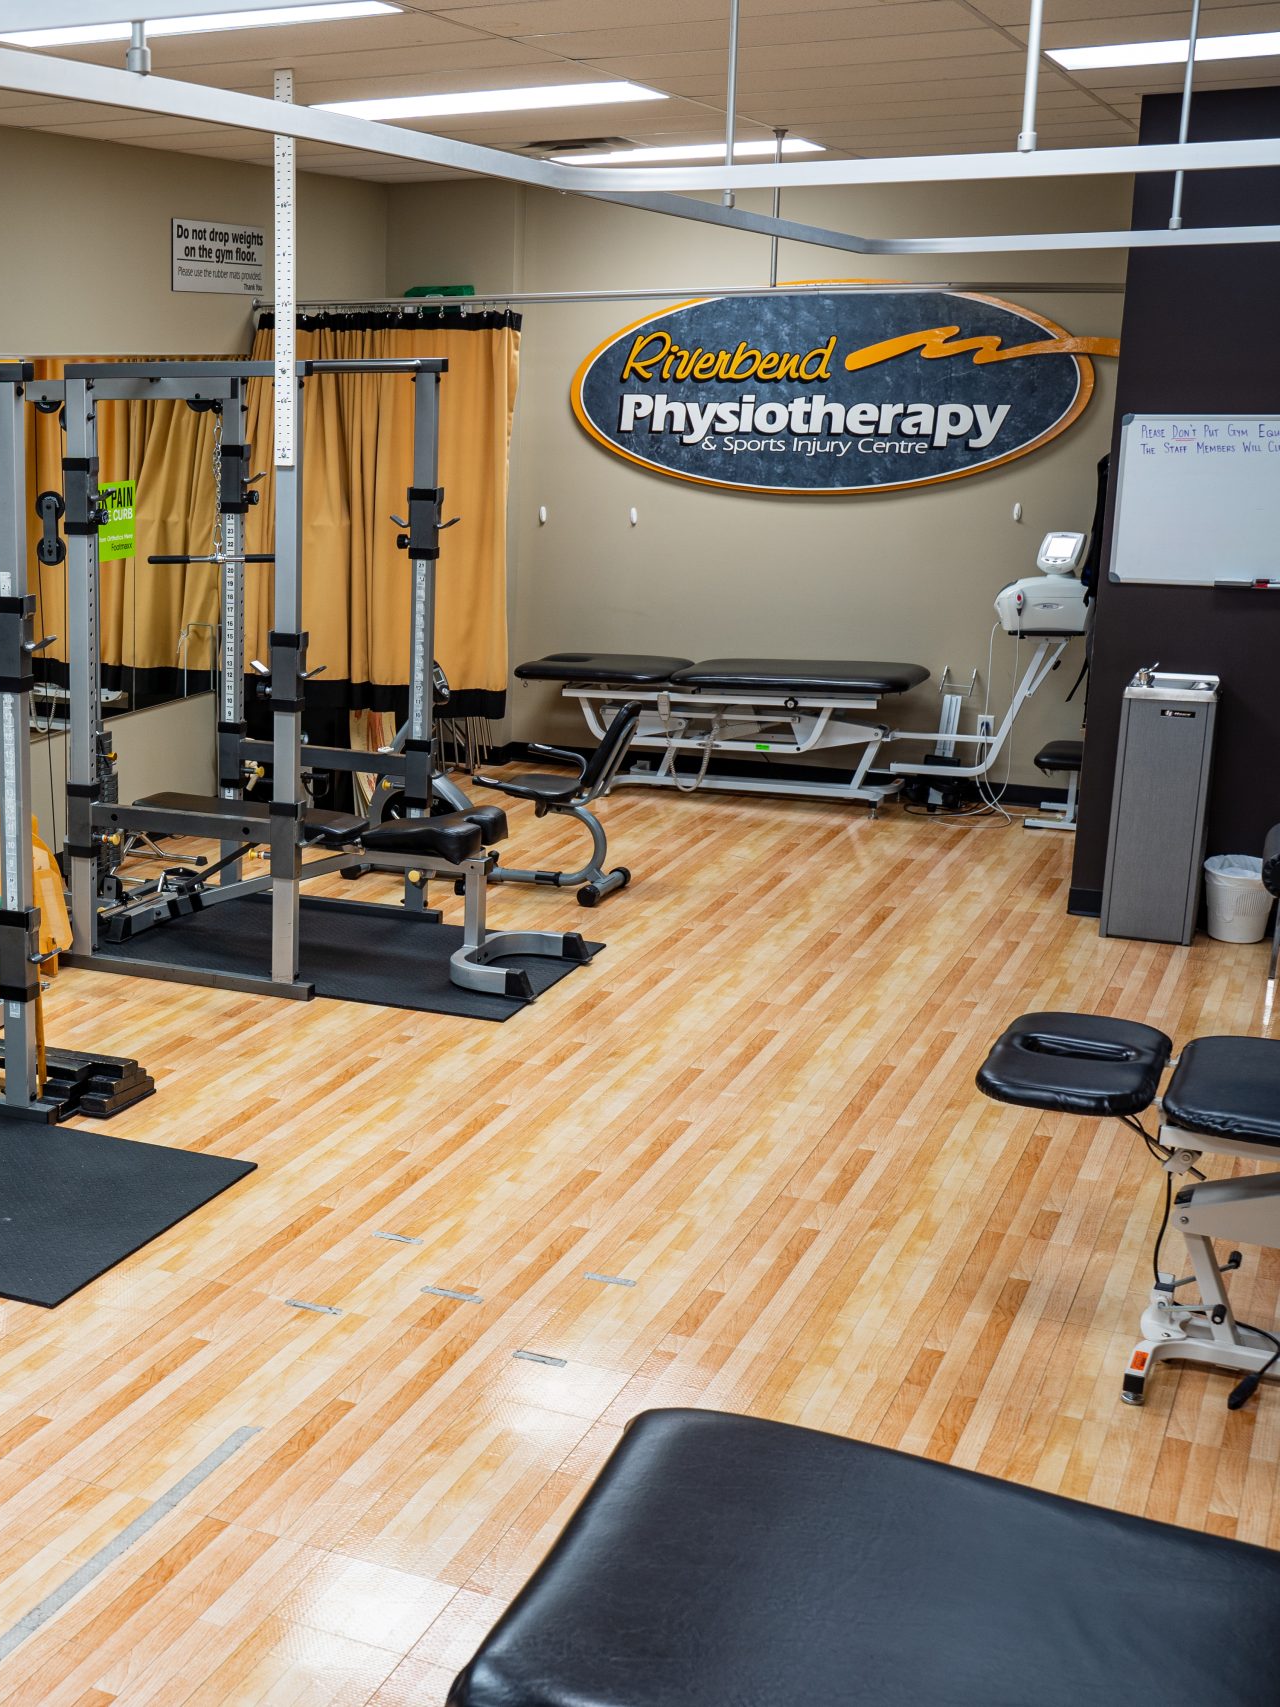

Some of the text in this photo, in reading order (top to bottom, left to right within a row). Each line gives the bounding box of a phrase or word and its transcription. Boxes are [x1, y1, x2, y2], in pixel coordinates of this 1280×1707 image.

[176, 224, 264, 249] Do not drop weights
[184, 245, 256, 263] on the gym floor.
[178, 266, 262, 282] Please use the rubber mats provided.
[244, 283, 255, 291] Thank
[621, 331, 837, 381] Riverbend
[619, 393, 1011, 449] Physiotherapy
[701, 436, 928, 457] & Sports Injury Centre
[111, 486, 132, 508] PAIN
[113, 508, 133, 521] CURB
